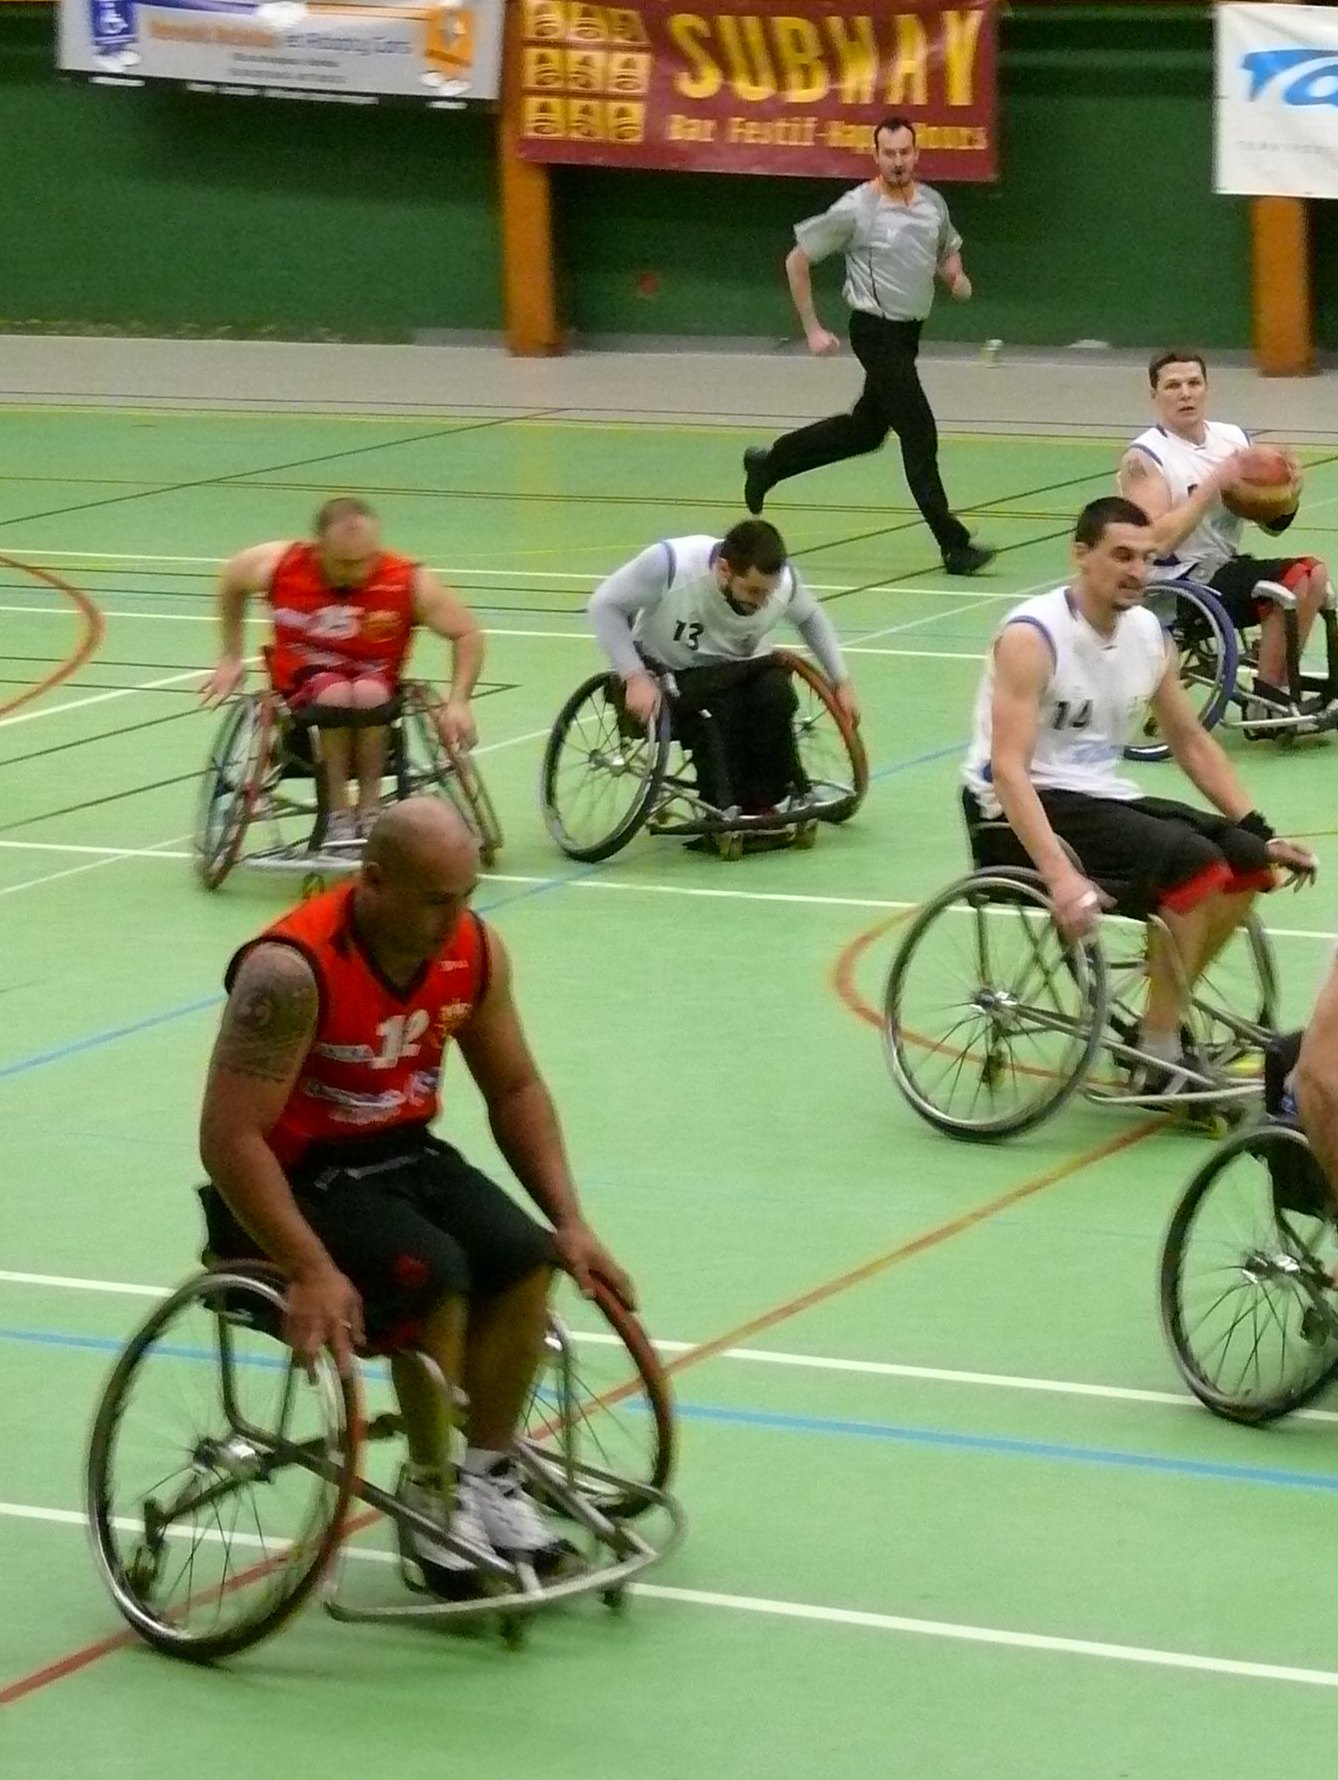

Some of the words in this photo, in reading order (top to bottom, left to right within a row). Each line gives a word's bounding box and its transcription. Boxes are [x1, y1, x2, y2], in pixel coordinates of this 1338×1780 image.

[668, 9, 984, 105] SUBWAY
[673, 620, 704, 650] 13
[1053, 700, 1093, 731] 14
[368, 1009, 430, 1069] 12
